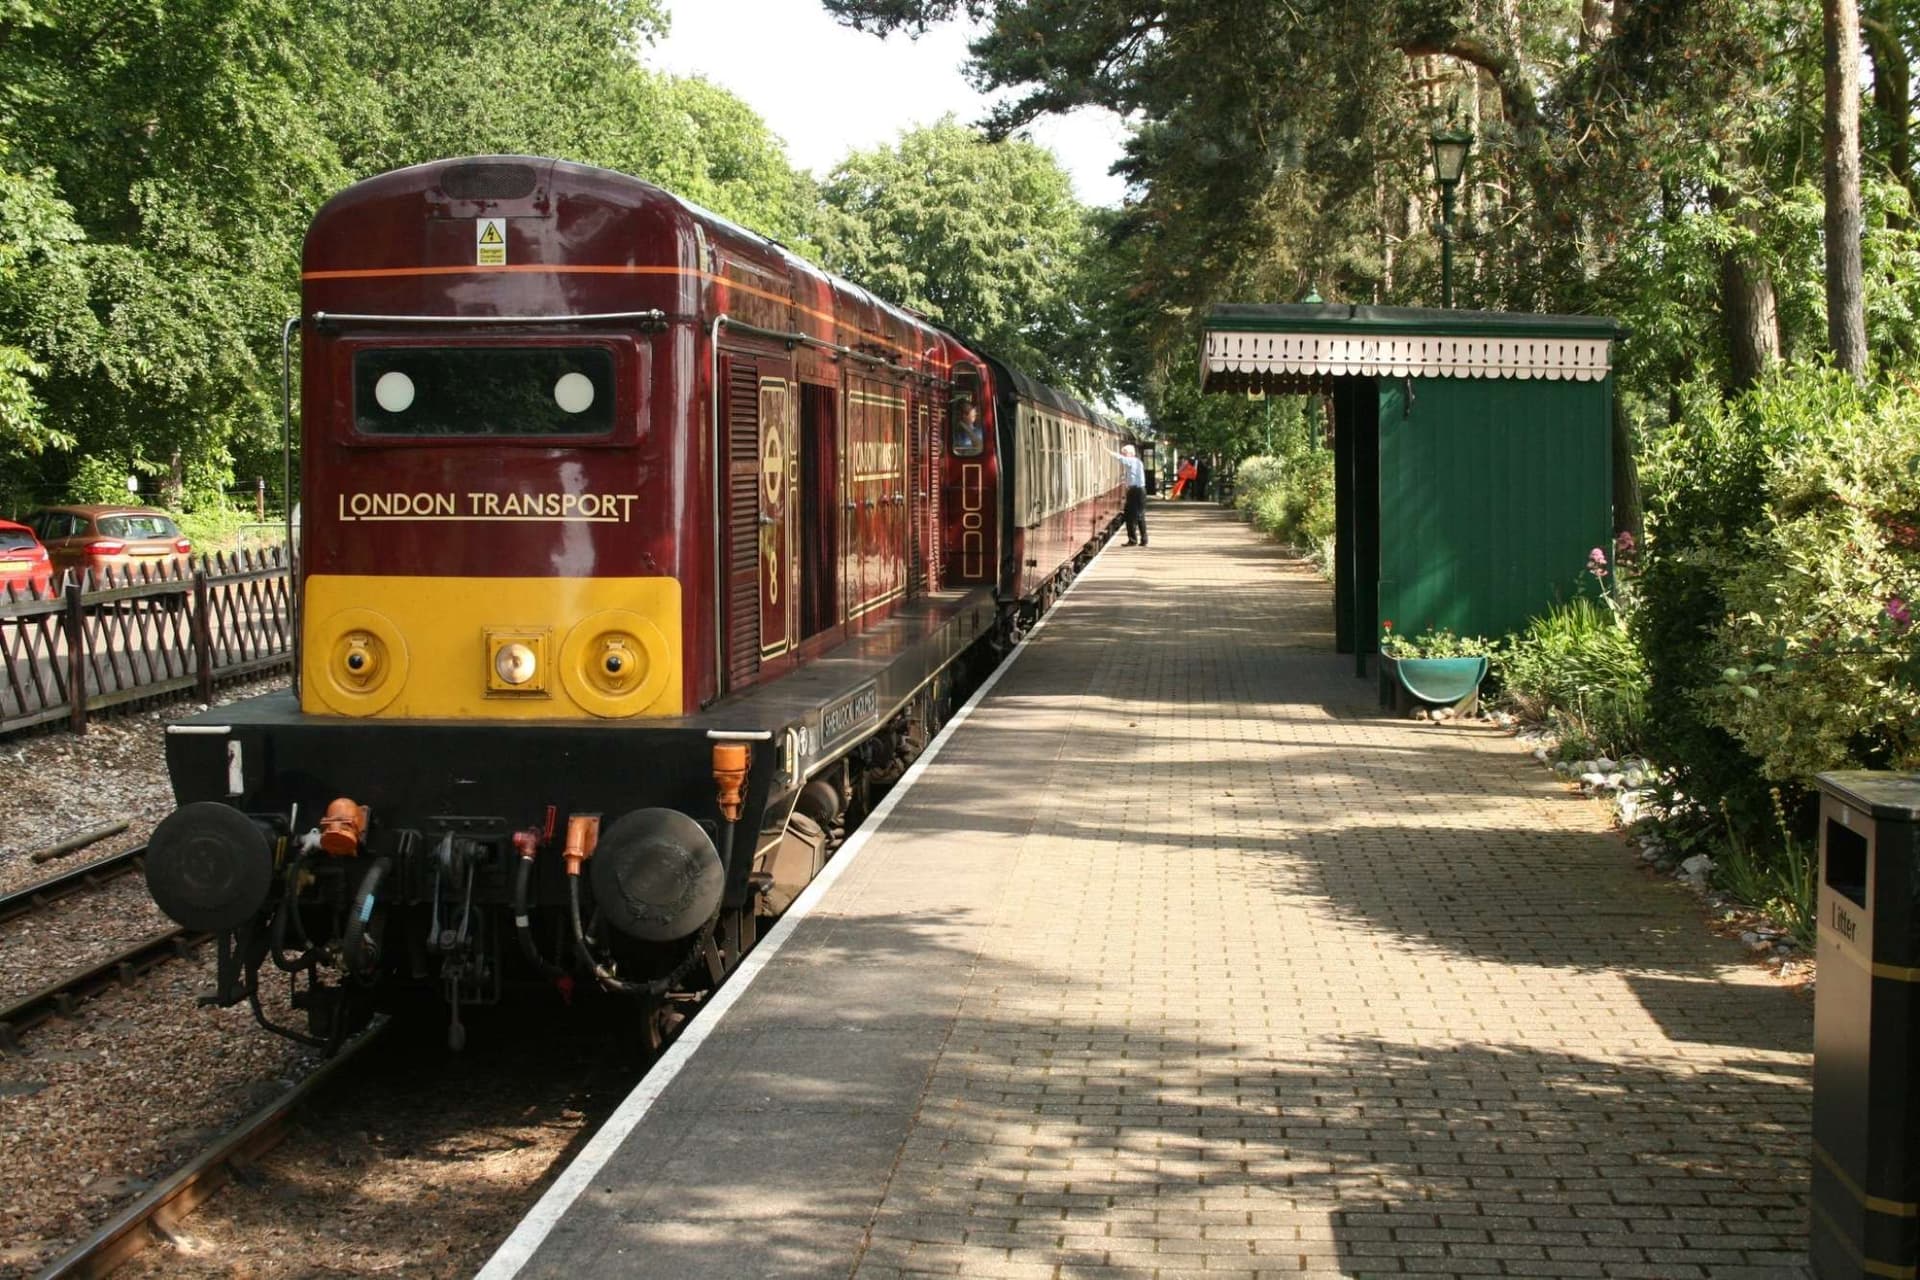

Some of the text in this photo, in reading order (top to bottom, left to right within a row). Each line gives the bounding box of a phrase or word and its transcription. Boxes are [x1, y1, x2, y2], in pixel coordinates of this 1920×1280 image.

[339, 492, 639, 522] LONDON TRANSPORT
[769, 551, 778, 605] 8
[1832, 901, 1856, 943] Litter
